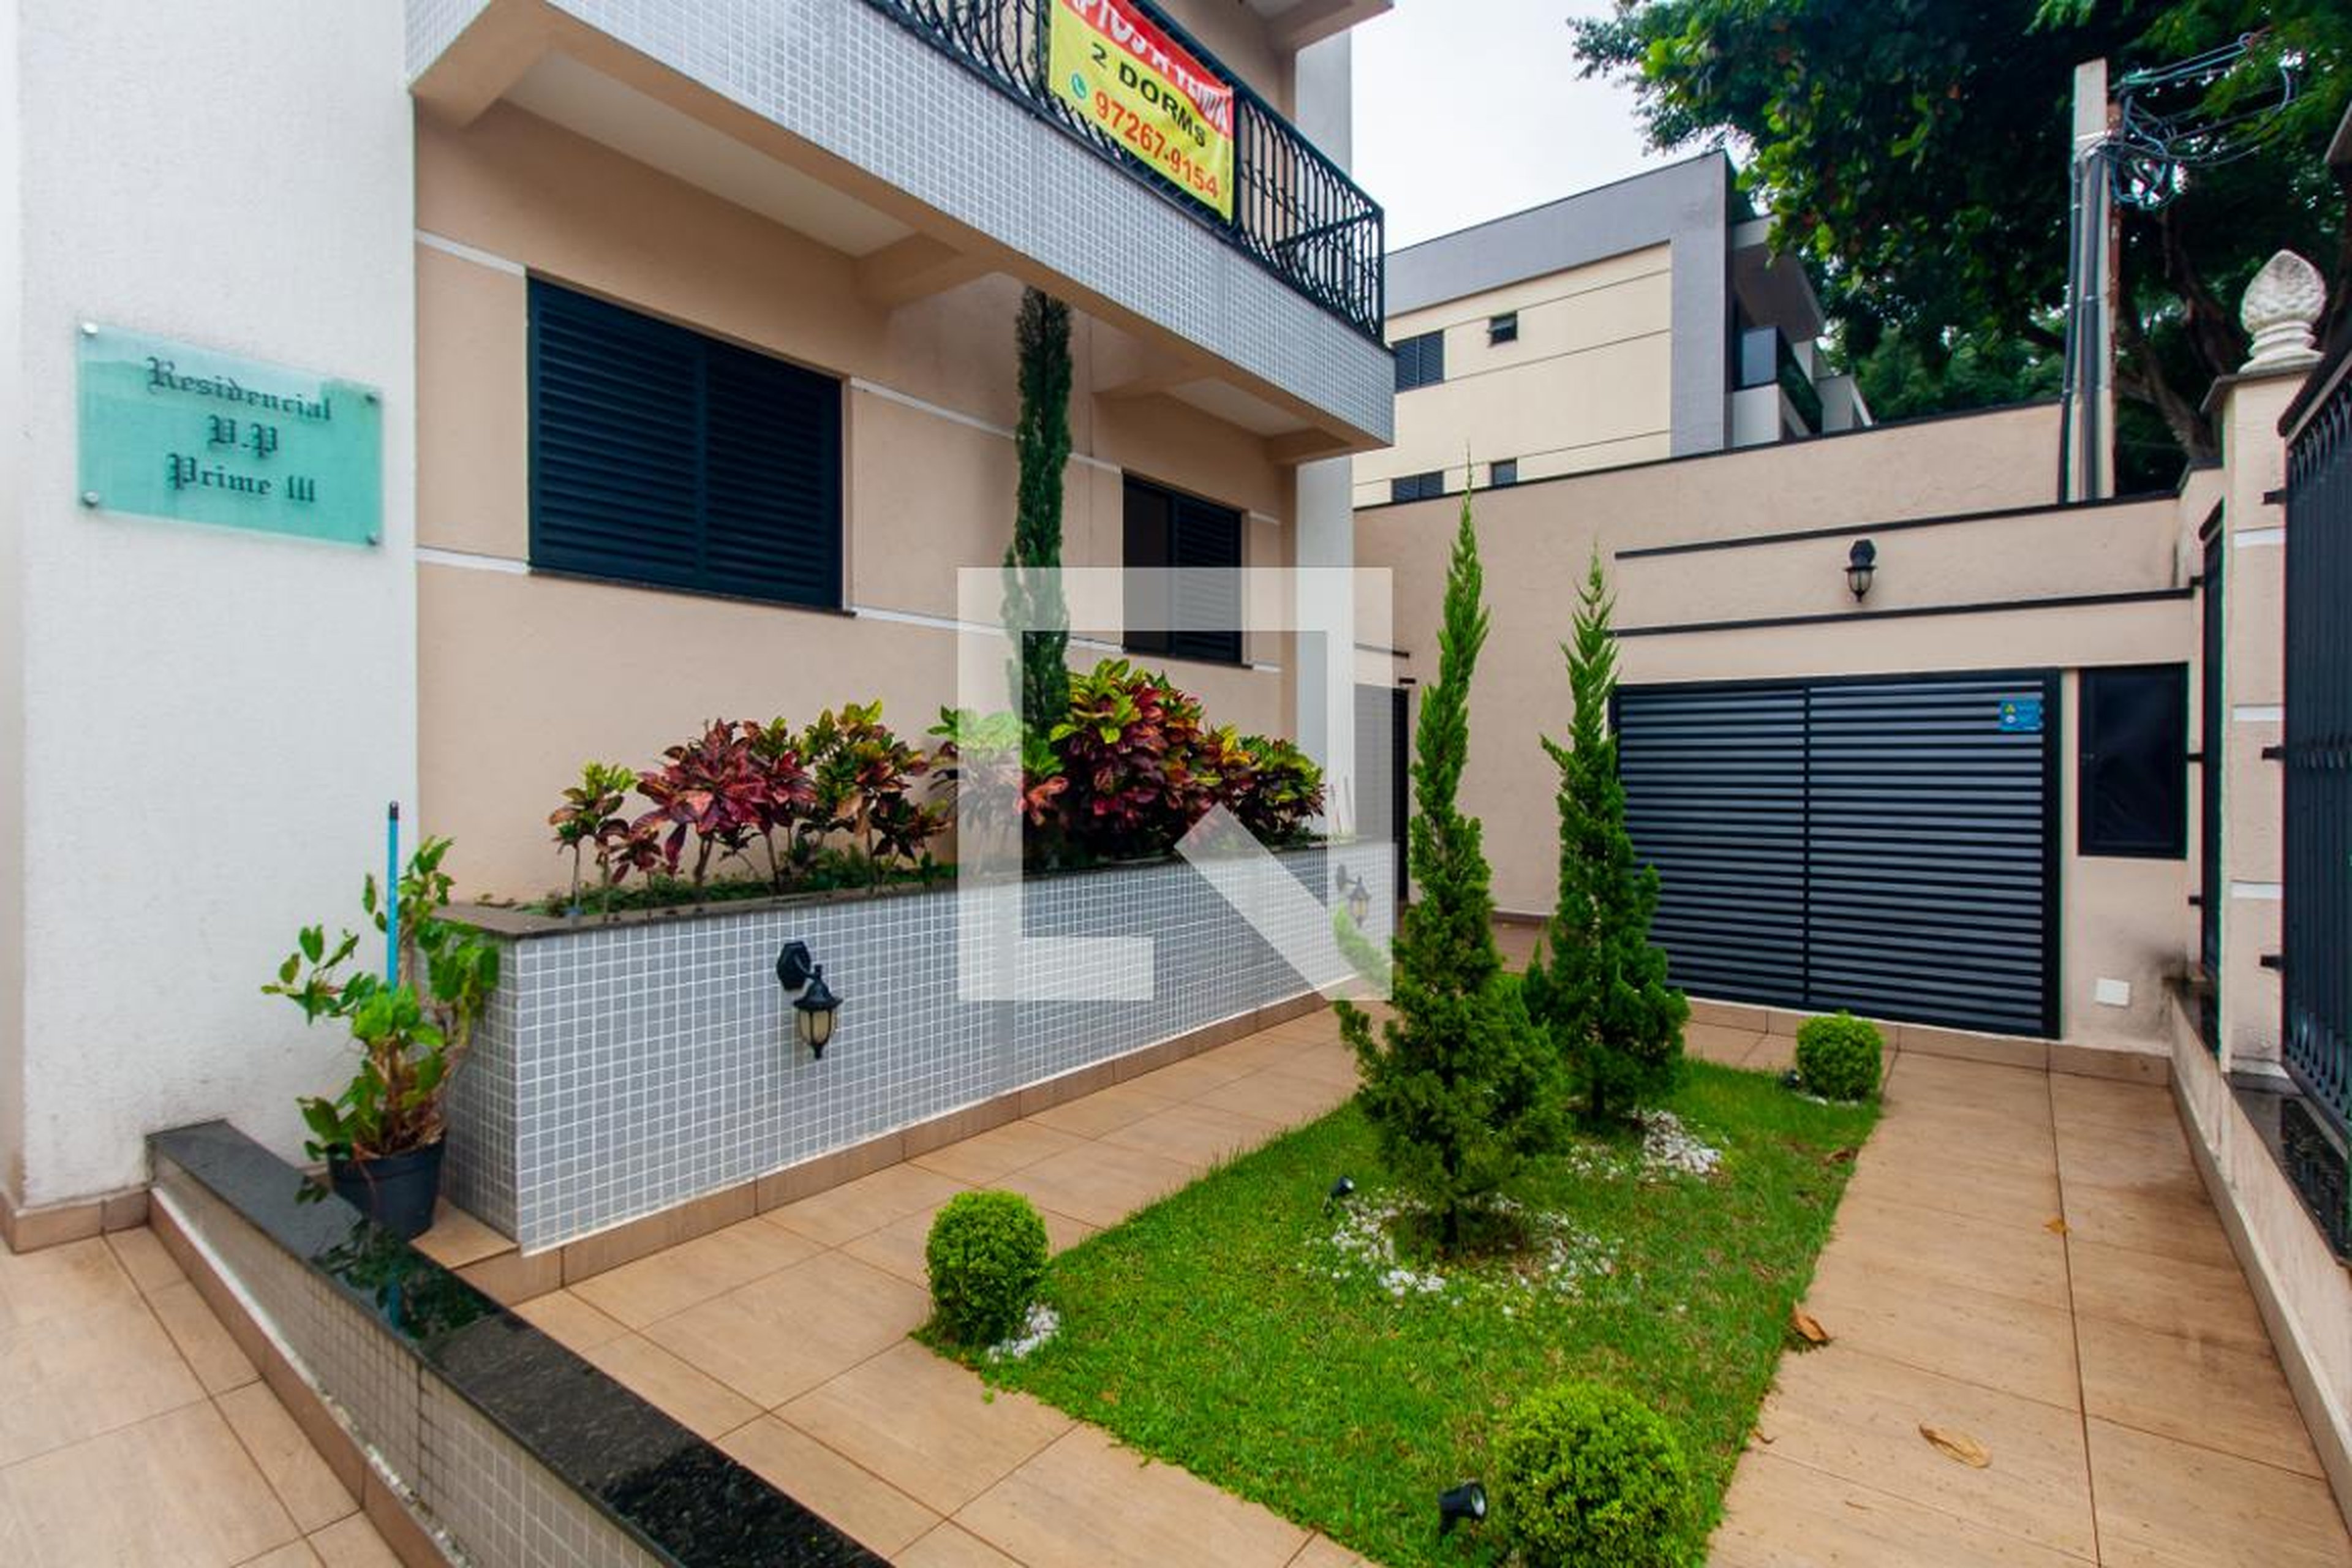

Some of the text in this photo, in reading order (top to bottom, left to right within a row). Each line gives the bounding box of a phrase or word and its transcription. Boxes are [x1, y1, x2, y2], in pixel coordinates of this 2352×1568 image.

[1091, 42, 1206, 148] 2 DORMS
[146, 356, 332, 421] Residencial
[167, 452, 272, 495] Prime
